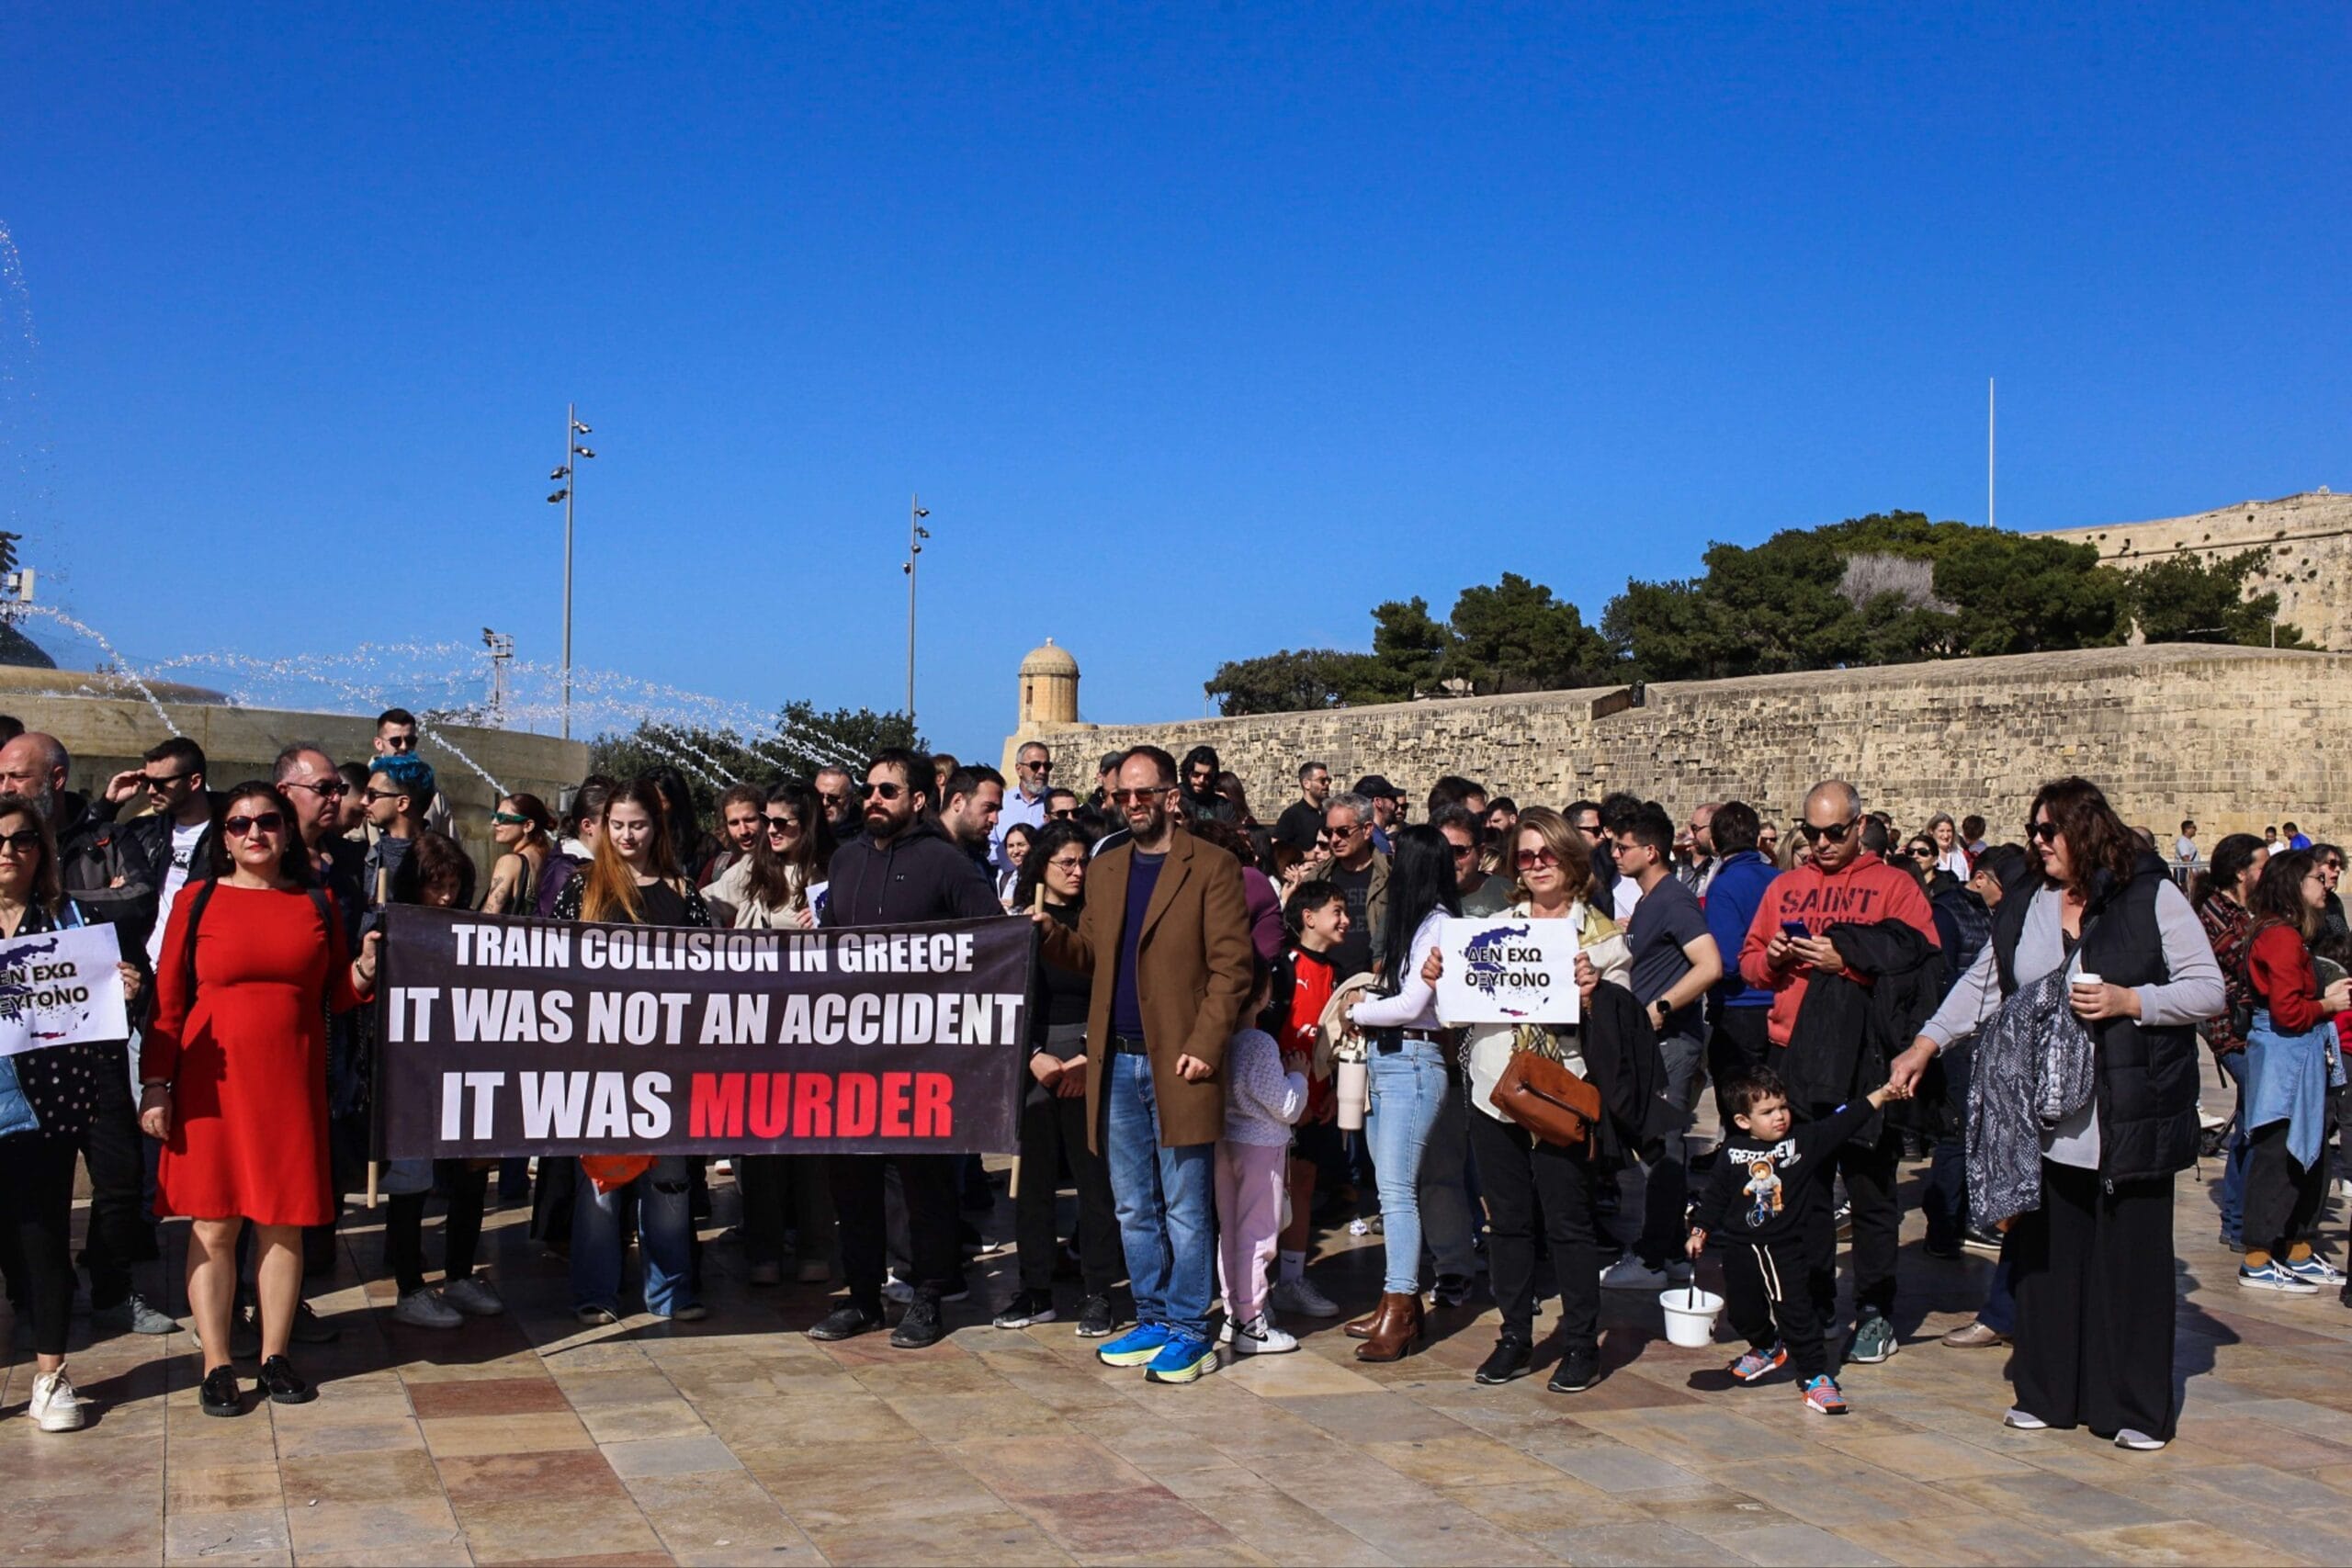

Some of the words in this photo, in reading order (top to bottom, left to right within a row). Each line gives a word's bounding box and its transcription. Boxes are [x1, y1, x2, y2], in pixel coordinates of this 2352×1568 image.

[1780, 886, 1879, 914] SAINT
[451, 924, 570, 968] TRAIN
[581, 929, 779, 972] COLLISION
[789, 934, 828, 972] IN
[837, 933, 974, 973] GREECE
[1467, 948, 1502, 962] ΔΕΝ
[1508, 948, 1543, 962] ΕΧΩ
[0, 968, 26, 986] ΕΝ
[32, 963, 77, 981] ΕΧΩ
[1465, 972, 1551, 987] ΟΞΥΓΟΝΟ
[0, 987, 89, 1014] ΞΥΓΟΝΟ
[388, 987, 440, 1043] IT
[451, 987, 573, 1043] WAS
[587, 991, 692, 1045] NOT
[699, 993, 770, 1044] AN
[778, 993, 1024, 1045] ACCIDENT
[441, 1071, 505, 1141] IT
[519, 1070, 672, 1139] WAS
[689, 1071, 954, 1139] MURDER
